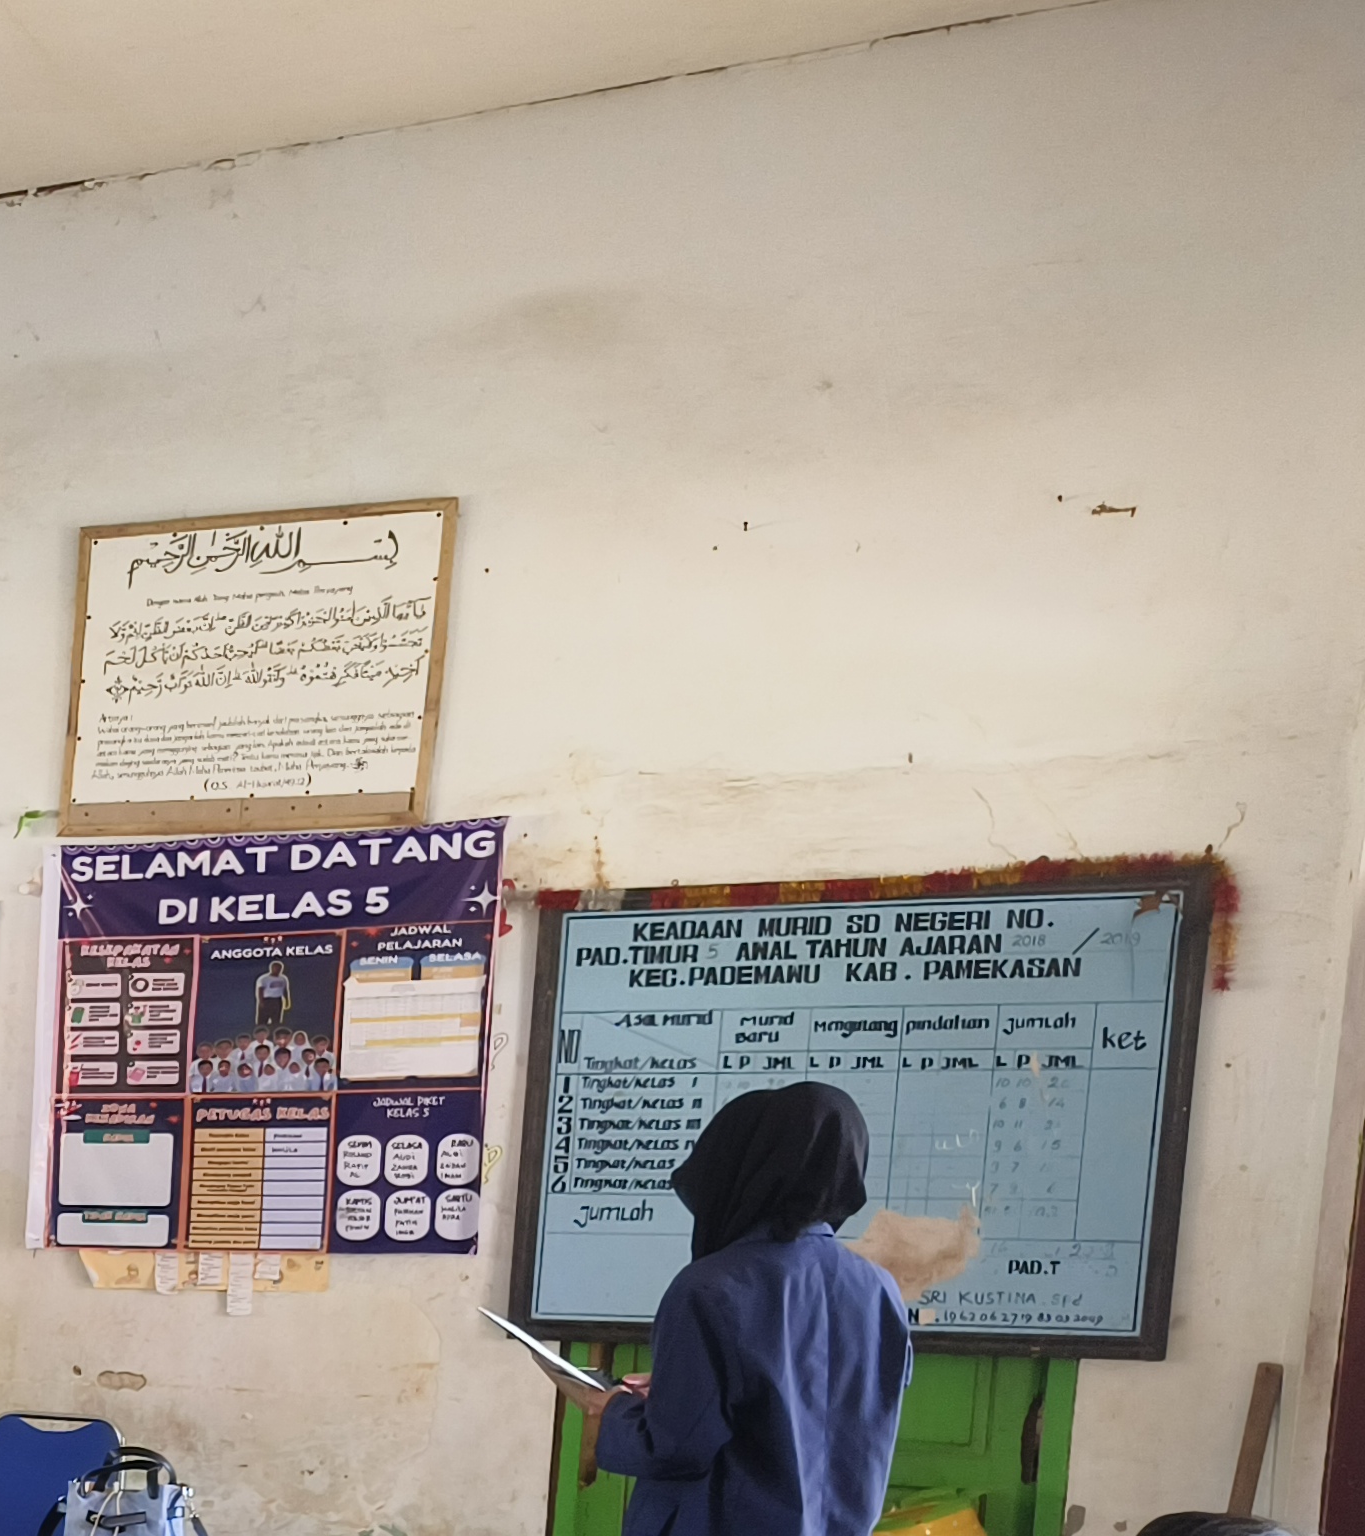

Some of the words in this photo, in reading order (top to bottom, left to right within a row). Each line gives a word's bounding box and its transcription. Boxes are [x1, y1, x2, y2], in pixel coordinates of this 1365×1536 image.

[70, 846, 278, 883] SELAMAT
[290, 831, 497, 871] DATANG
[157, 896, 199, 926] DI
[209, 887, 353, 924] KELAS
[364, 885, 391, 916] 5
[389, 924, 452, 937] JADWAL
[631, 918, 744, 943] KEADAAN
[757, 914, 833, 939] MURID
[845, 913, 881, 934] SD
[894, 910, 992, 933] NEGERI
[1005, 908, 1056, 931] NO.
[210, 946, 283, 962] ANGGOTA
[285, 943, 335, 957] KELAS
[377, 938, 463, 951] PELAJARAN
[574, 944, 700, 967] PAD.TIMUR
[706, 943, 719, 959] 5
[805, 937, 887, 960] TAHUN
[899, 933, 1003, 957] AJARAN
[359, 955, 399, 966] SENIN
[428, 952, 483, 963] SELASA
[922, 956, 1083, 981] PAMEKASAN
[1101, 1026, 1148, 1051] ket
[722, 1055, 733, 1069] L
[738, 1055, 752, 1070] P
[762, 1055, 797, 1071] JML
[809, 1055, 820, 1068] L
[828, 1055, 841, 1069] P
[850, 1055, 885, 1070] JML
[902, 1056, 913, 1069] L
[920, 1056, 934, 1070] P
[941, 1056, 980, 1070] JML
[995, 1054, 1008, 1068] L
[1017, 1054, 1031, 1069] P
[1041, 1055, 1084, 1070] JML
[561, 1076, 572, 1094] 1
[386, 1107, 421, 1119] KELAS
[557, 1095, 574, 1114] 2
[196, 1107, 273, 1122] PETUGAS
[275, 1106, 332, 1121] KELAS
[556, 1116, 572, 1135] 3
[554, 1136, 571, 1154] 4
[553, 1155, 570, 1175] 5
[550, 1174, 568, 1194] 6
[1007, 1259, 1061, 1275] PAD.T
